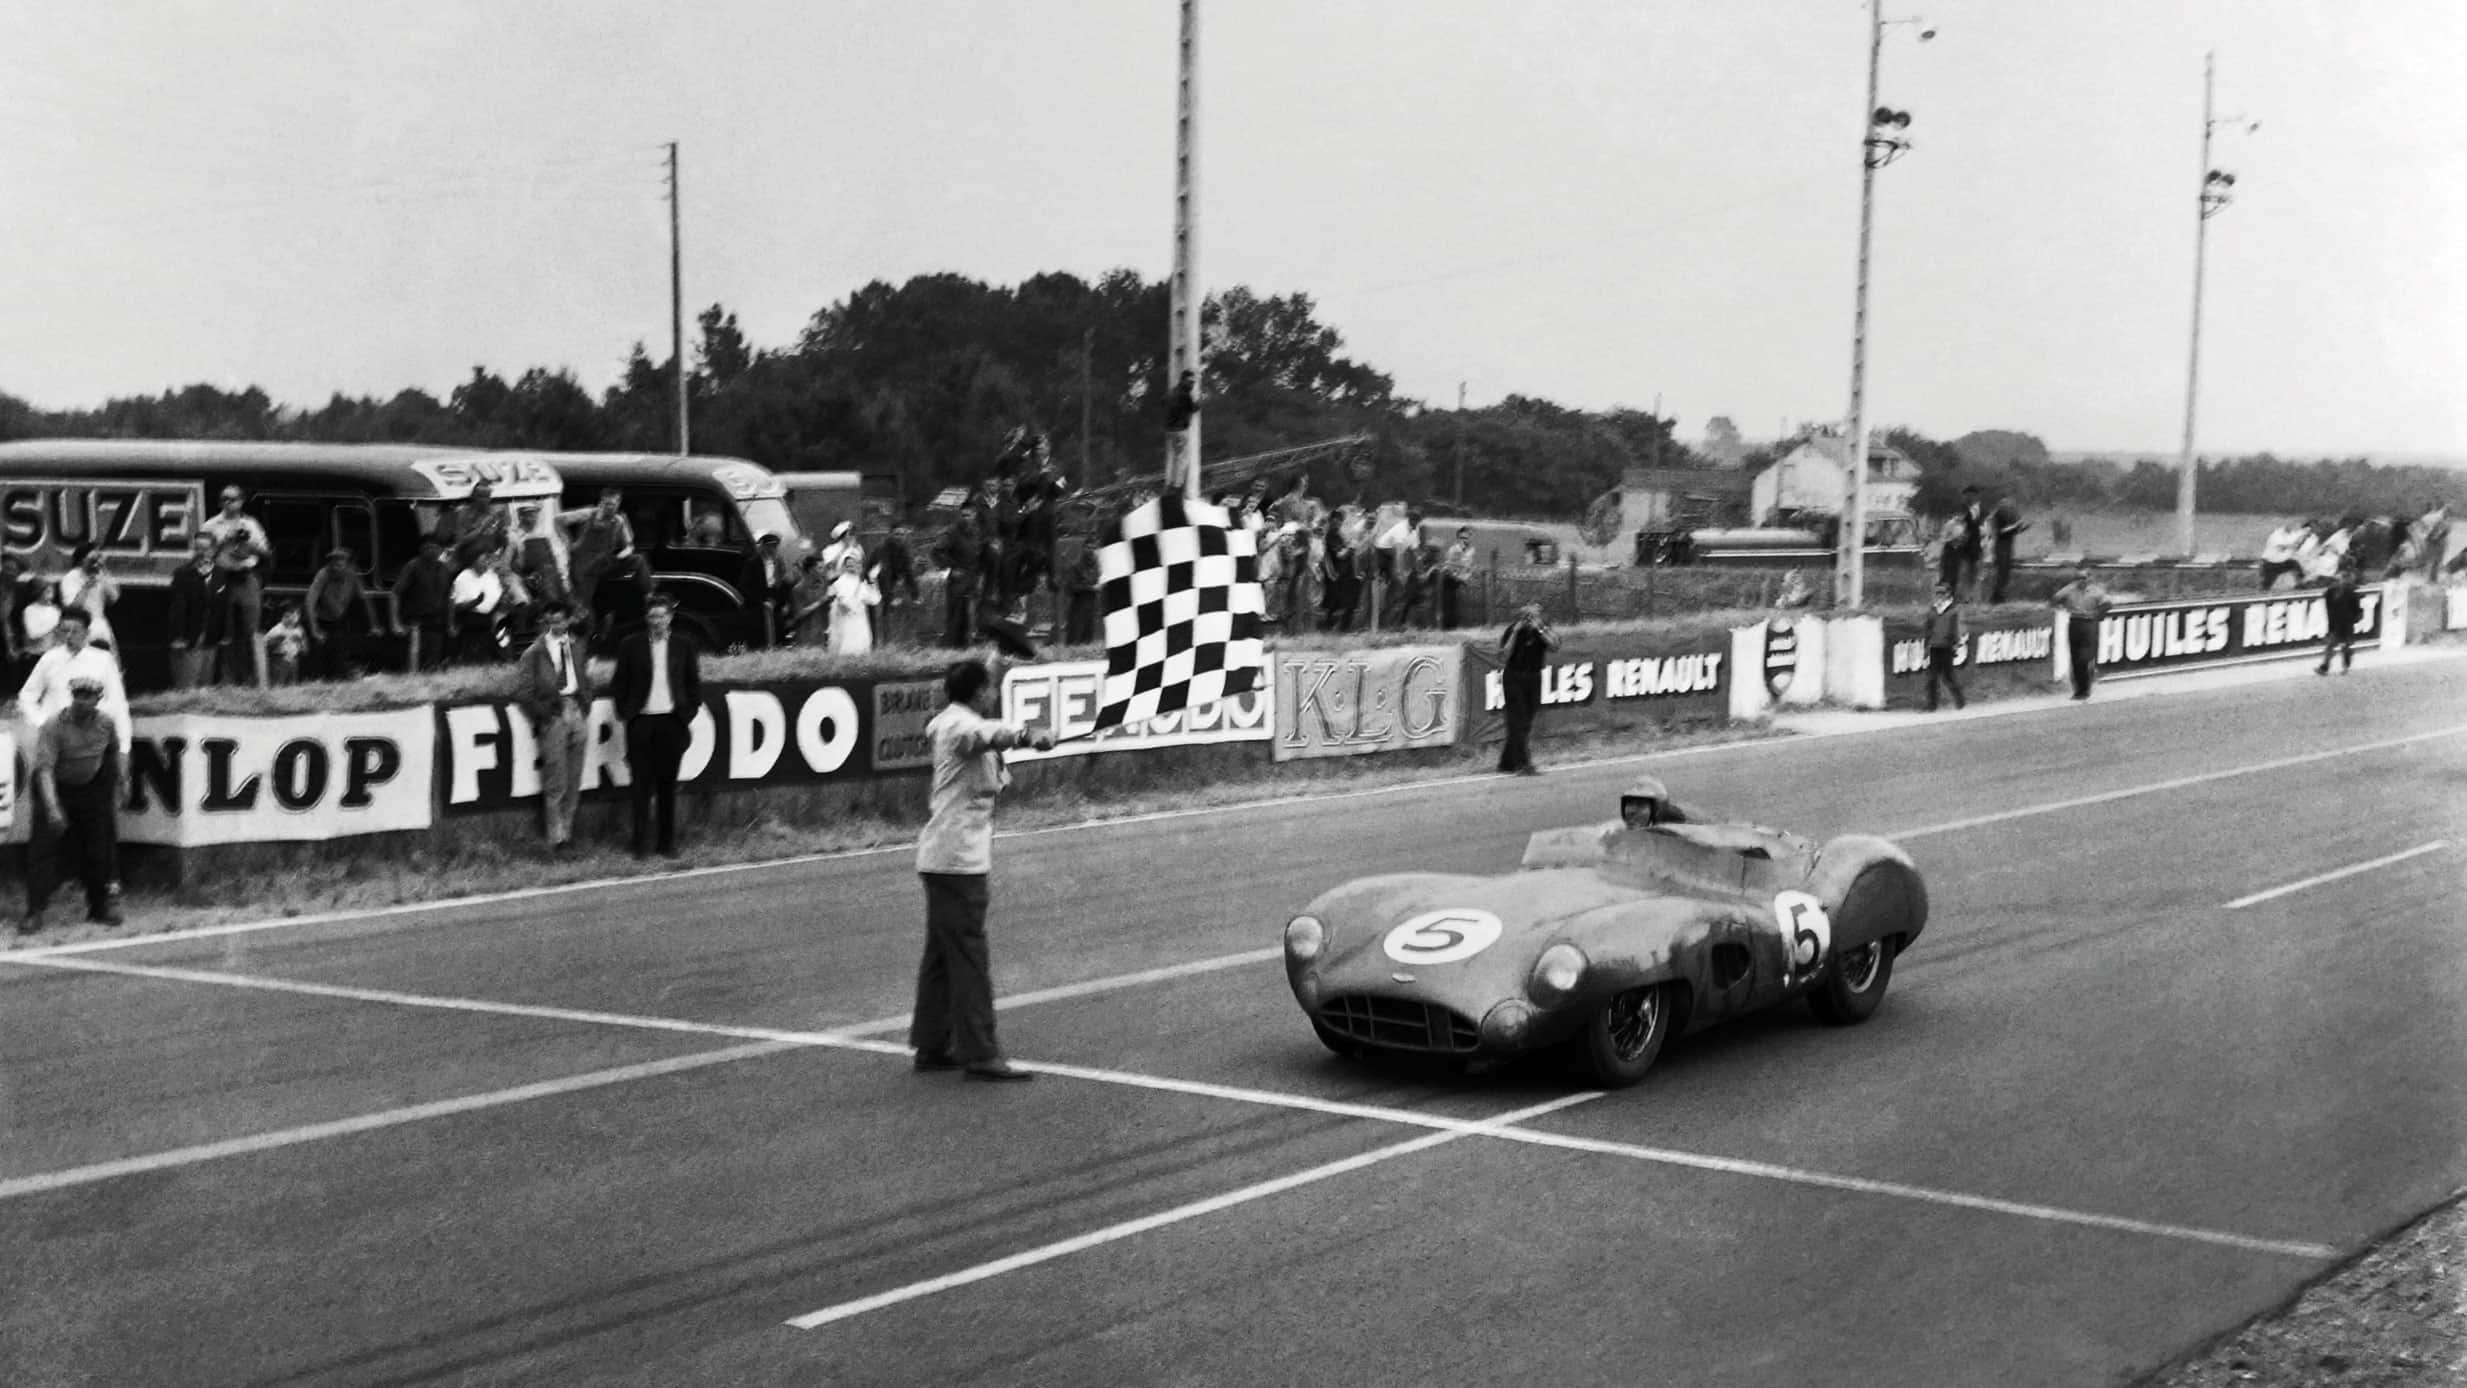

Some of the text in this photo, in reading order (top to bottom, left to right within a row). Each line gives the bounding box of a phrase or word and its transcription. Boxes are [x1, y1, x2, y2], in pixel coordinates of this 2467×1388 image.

[0, 487, 195, 559] SUZE
[1975, 627, 2053, 664] RENAULT
[2097, 593, 2383, 664] HUILES RENAT
[1485, 652, 1722, 711] HLES RENAULT
[15, 736, 401, 817] NLOP
[1401, 916, 1480, 953] 5
[1789, 902, 1821, 977] 5
